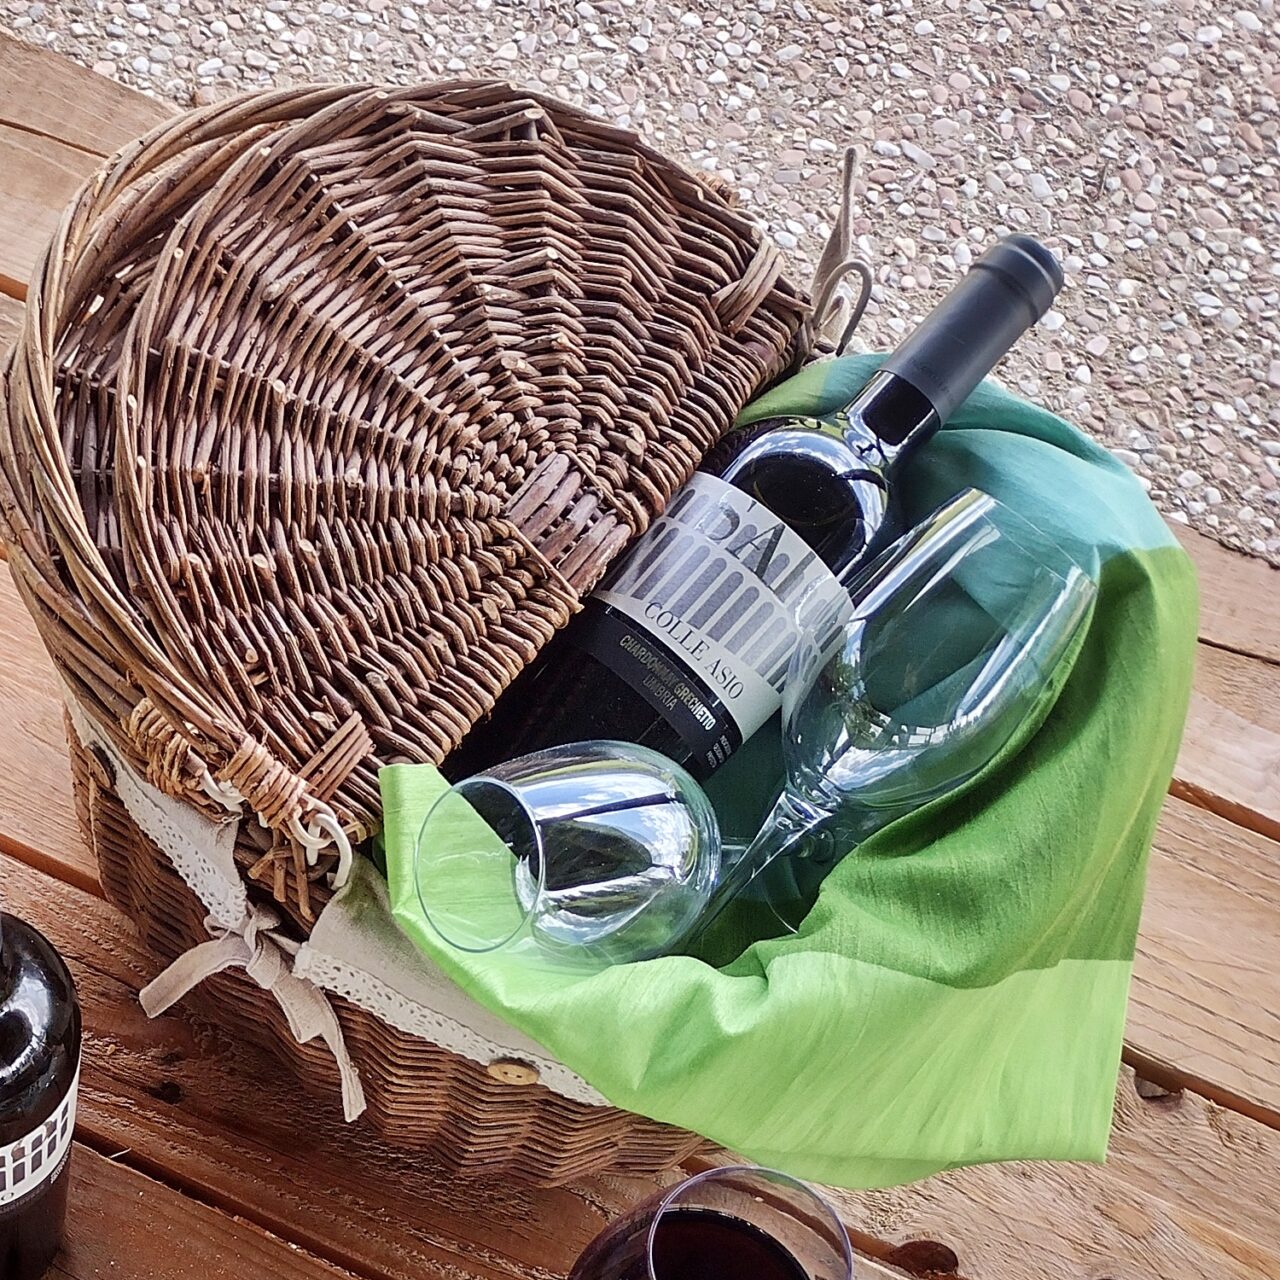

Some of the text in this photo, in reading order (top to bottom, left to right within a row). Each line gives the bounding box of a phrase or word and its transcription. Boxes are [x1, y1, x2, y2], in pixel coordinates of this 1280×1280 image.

[643, 601, 711, 662] COLLE
[704, 658, 745, 701] ASIO
[642, 673, 677, 711] UMBRIA
[673, 681, 717, 731] GRECHETTO
